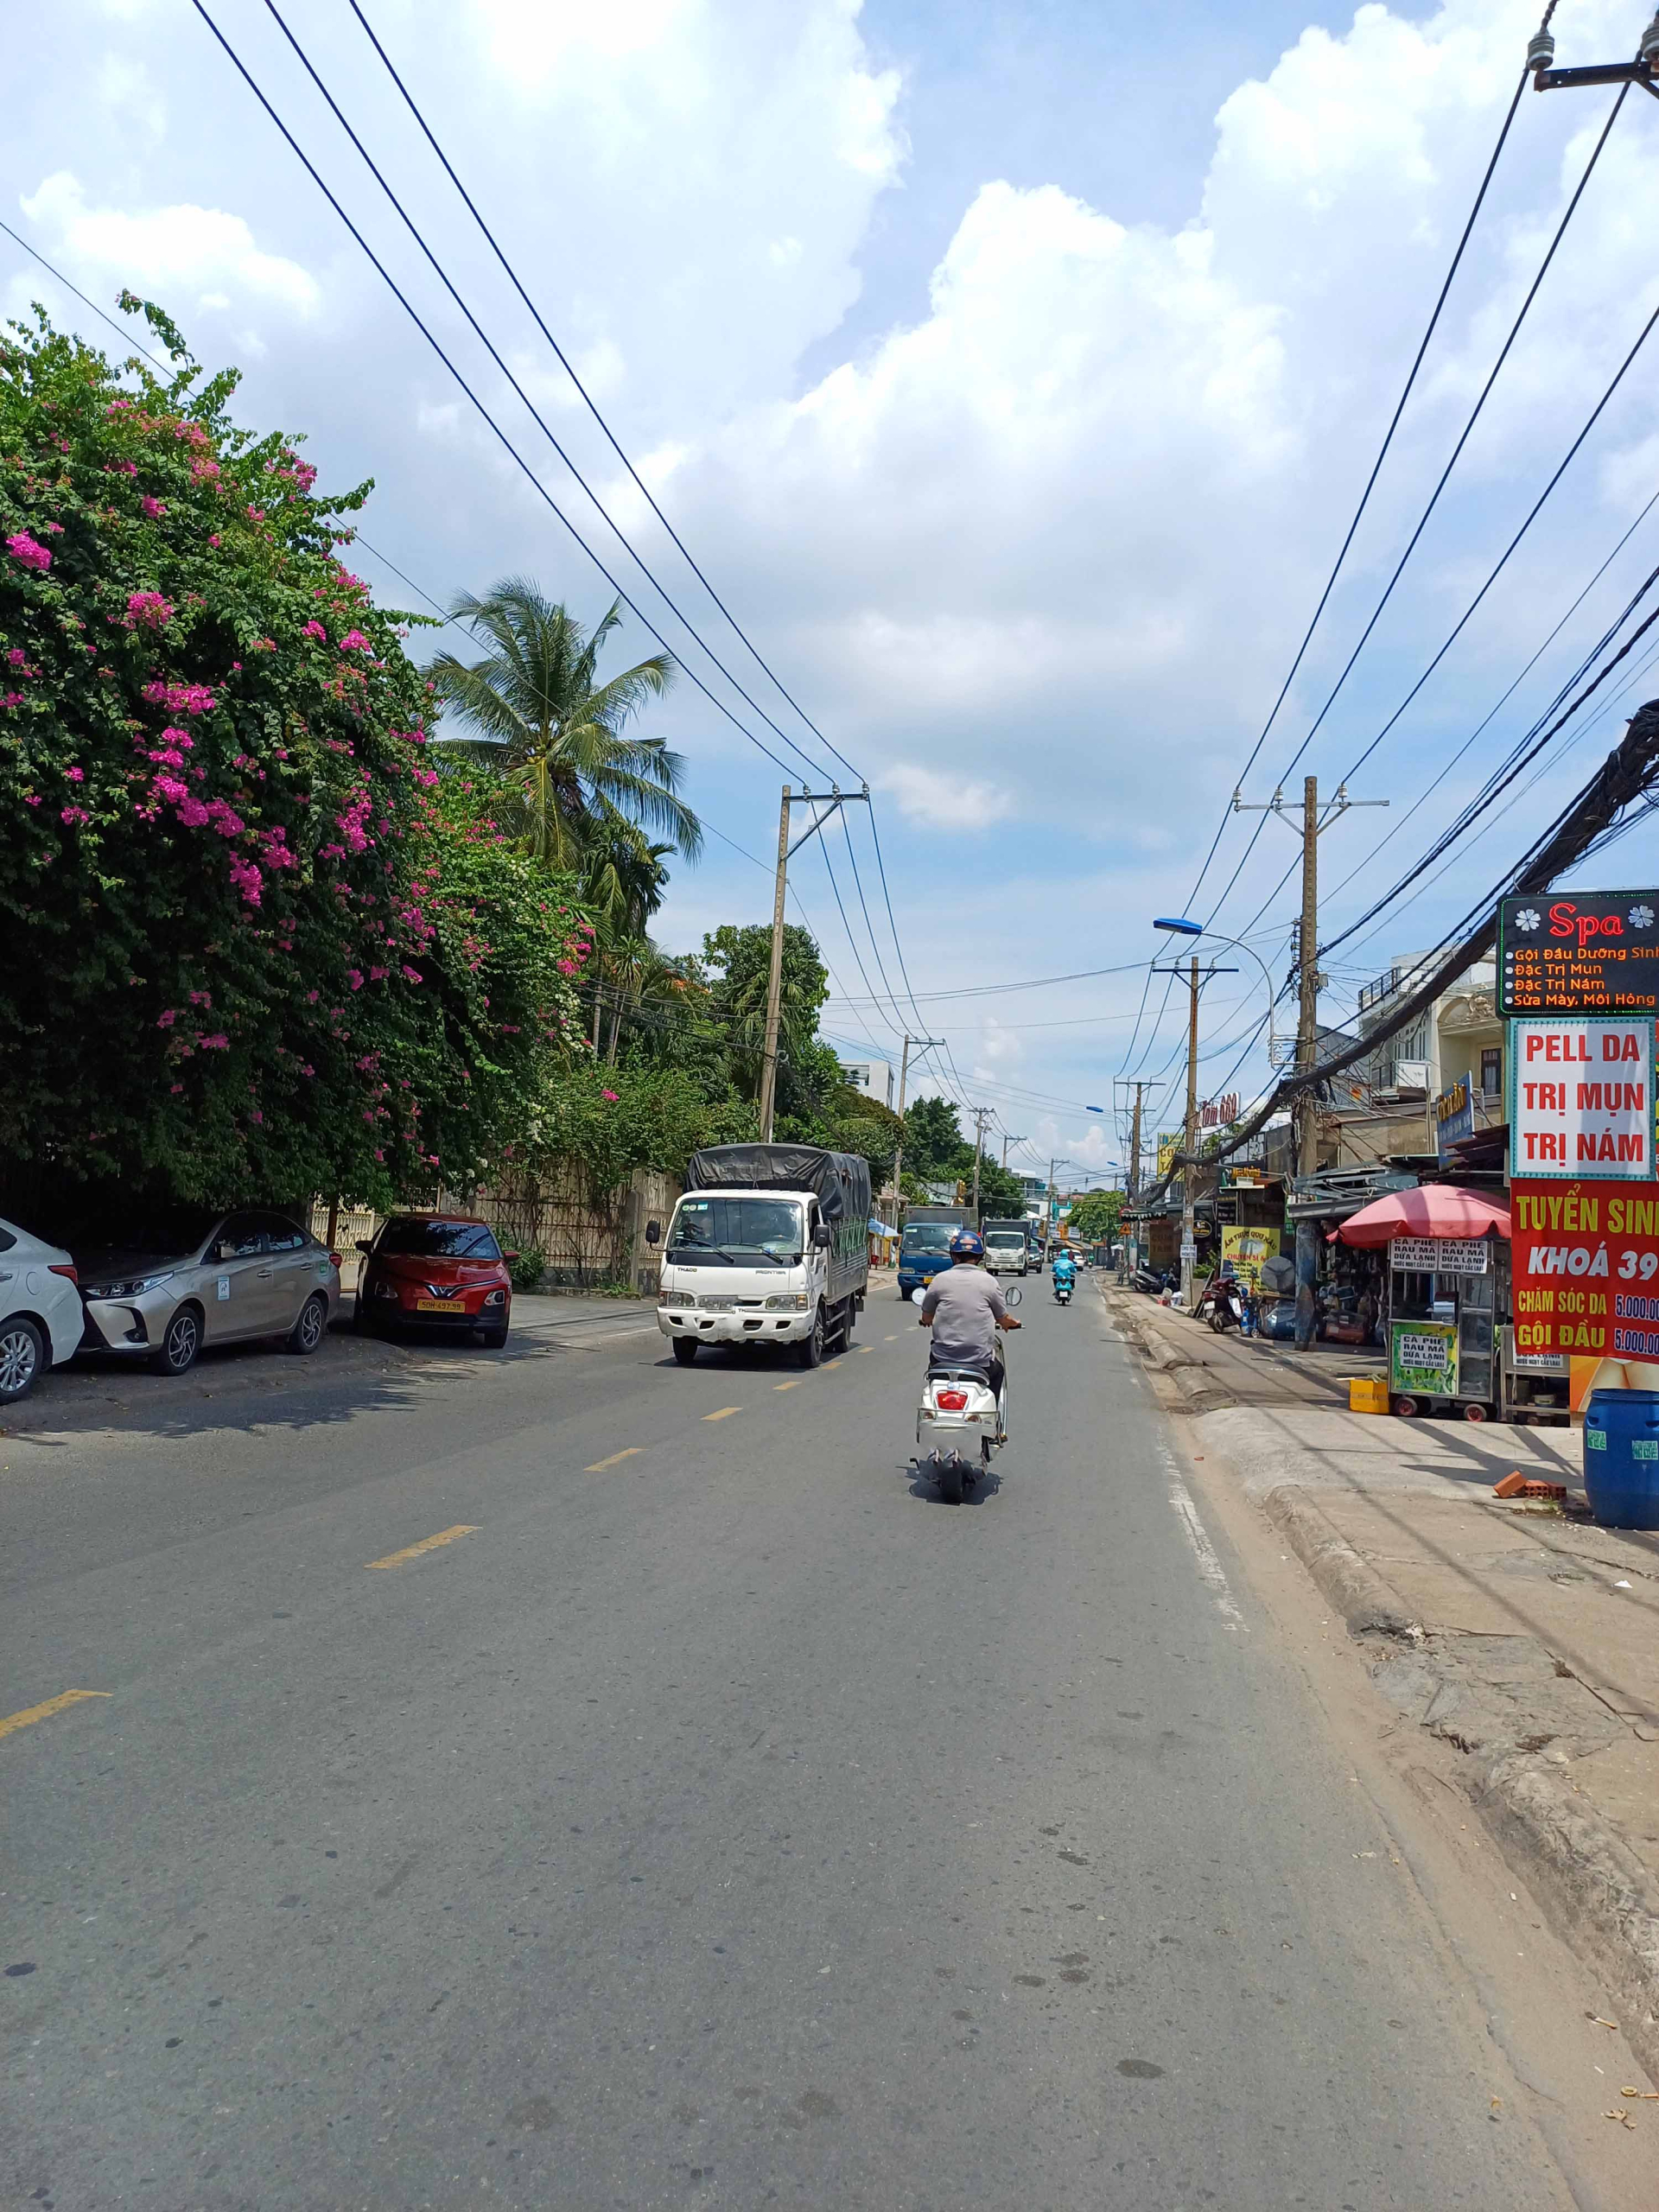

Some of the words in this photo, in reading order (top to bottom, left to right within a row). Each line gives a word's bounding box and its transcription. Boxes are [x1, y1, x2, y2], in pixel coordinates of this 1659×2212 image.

[1548, 902, 1624, 946] Spa
[1514, 963, 1542, 976] Đặc
[1515, 948, 1538, 962] Gội
[1577, 947, 1627, 961] Dưỡng
[1514, 979, 1542, 992] Đặc
[1570, 978, 1605, 990] Nám
[1526, 1034, 1592, 1062] PELL
[1602, 1033, 1640, 1062] DA
[1522, 1083, 1566, 1116] TRỊ
[1577, 1083, 1643, 1117] MỤN
[1523, 1133, 1567, 1166] TRỊ
[1577, 1127, 1643, 1162] NÁM
[1516, 1183, 1599, 1232] TUYỂN
[1528, 1240, 1609, 1277] KHOÁ
[1618, 1250, 1658, 1281] 39
[1518, 1286, 1554, 1313] CHĂM
[1558, 1287, 1585, 1313] SÓC
[1589, 1293, 1607, 1315] DA
[1518, 1319, 1551, 1351] GỘI
[1559, 1319, 1605, 1349] ĐẦU
